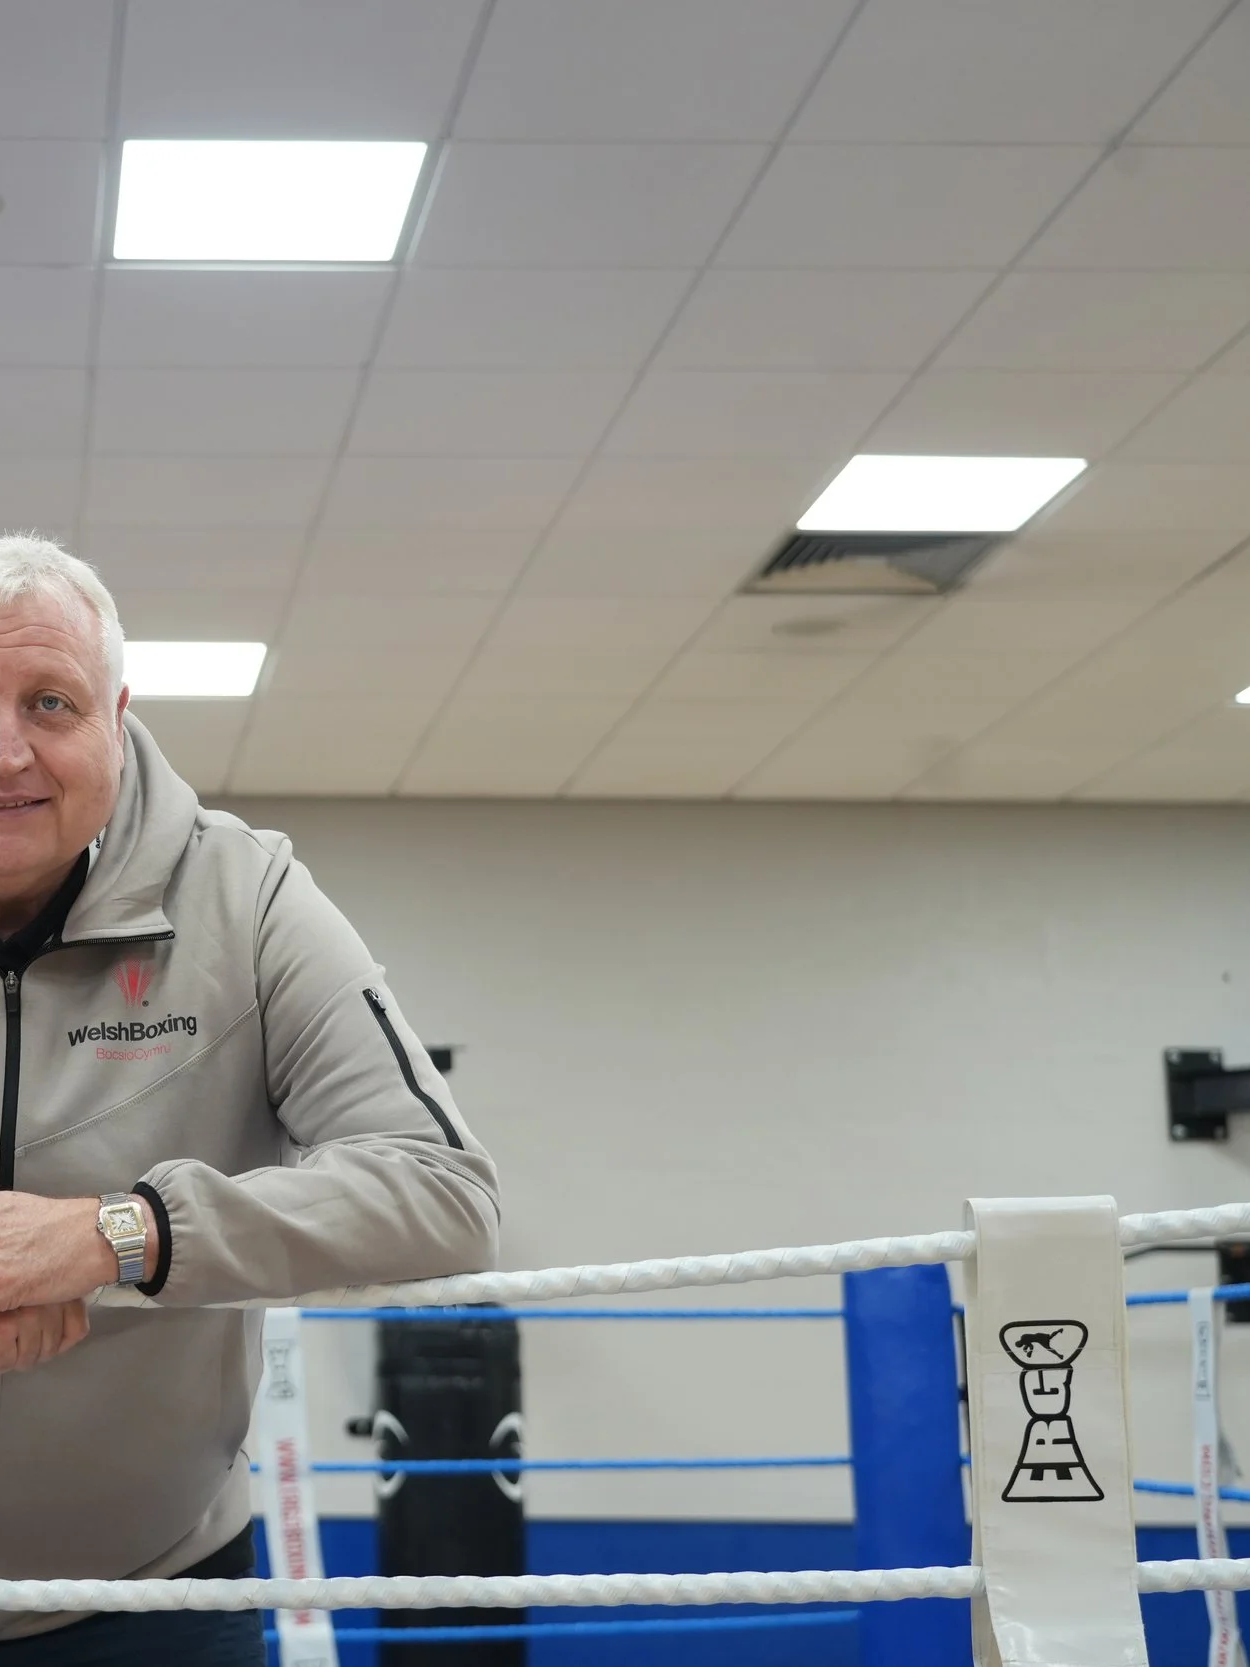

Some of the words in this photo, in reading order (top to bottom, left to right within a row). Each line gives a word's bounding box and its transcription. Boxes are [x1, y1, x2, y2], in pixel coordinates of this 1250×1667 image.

[68, 1013, 197, 1047] WelshBoxing
[96, 1044, 173, 1062] BocsioCymru
[999, 1319, 1105, 1502] ERGO
